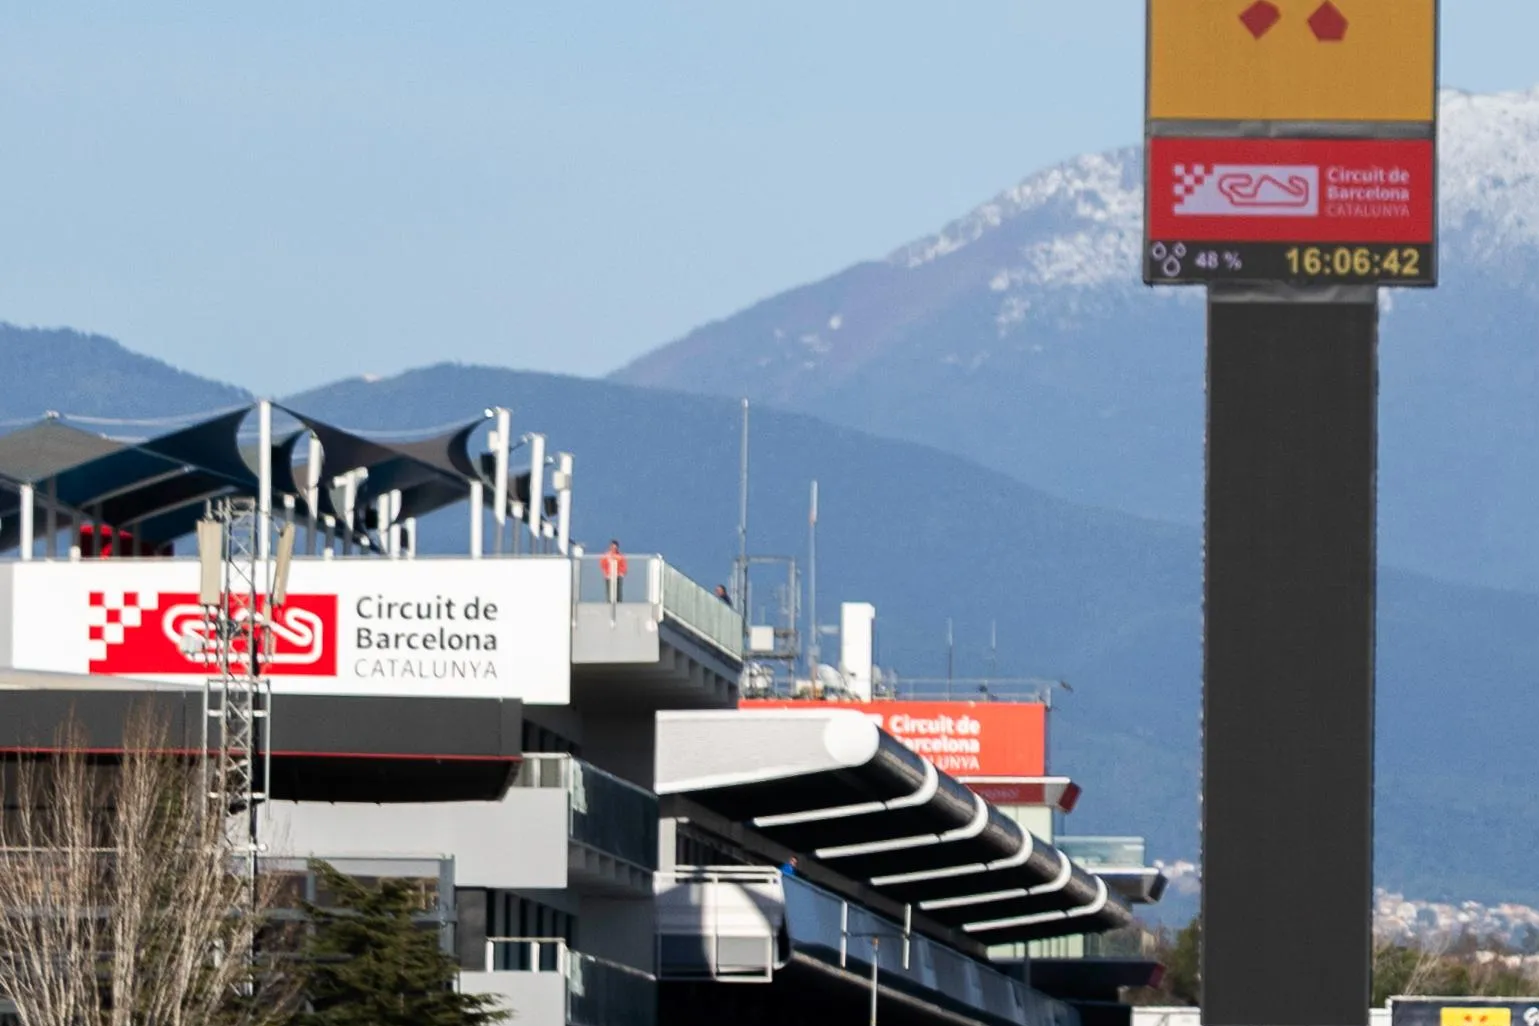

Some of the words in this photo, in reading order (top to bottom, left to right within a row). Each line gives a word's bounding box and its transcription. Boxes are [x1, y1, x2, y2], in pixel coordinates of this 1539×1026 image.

[1327, 166, 1385, 184] Circuit
[1389, 166, 1410, 185] de
[1327, 185, 1410, 200] Barcelona
[1326, 203, 1410, 217] CATALUNYA
[1195, 252, 1218, 269] 48
[1223, 252, 1242, 270] %
[1286, 248, 1420, 275] 16:06:42
[356, 594, 456, 620] Circuit
[463, 596, 498, 620] de
[356, 626, 498, 650] Barcelona
[354, 658, 498, 679] CATALUNYA
[889, 714, 955, 735] Circuit
[956, 714, 981, 735] de
[895, 734, 980, 753] arcelona
